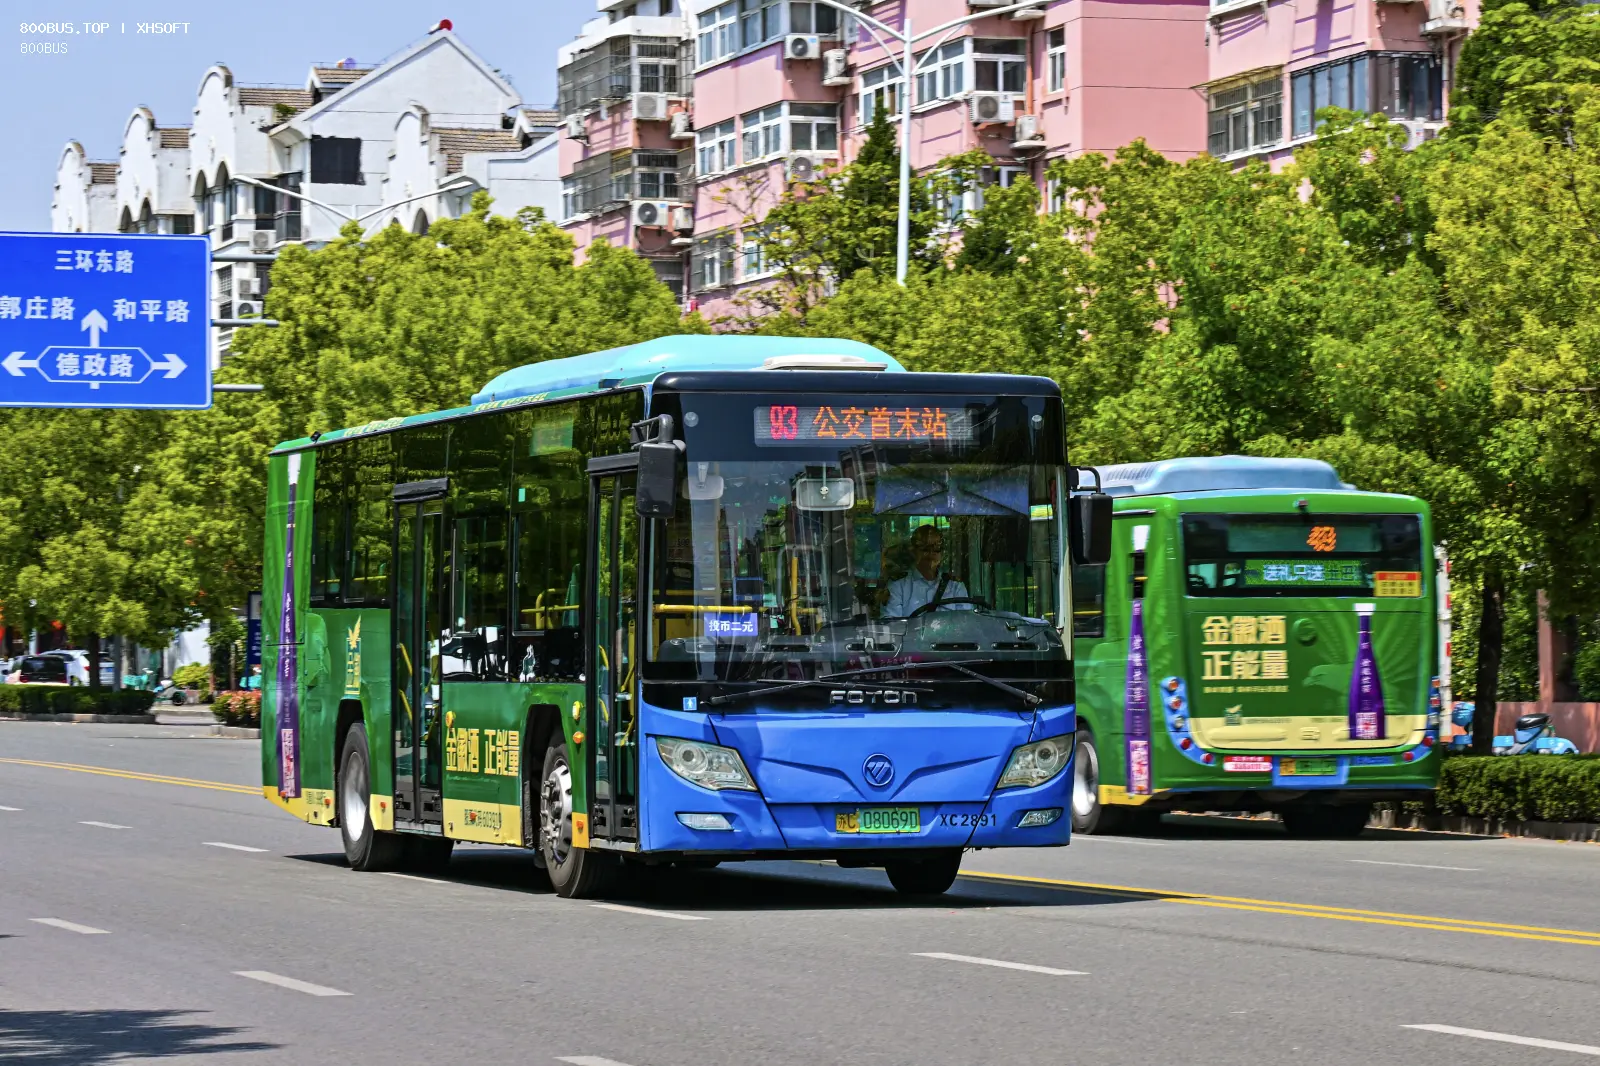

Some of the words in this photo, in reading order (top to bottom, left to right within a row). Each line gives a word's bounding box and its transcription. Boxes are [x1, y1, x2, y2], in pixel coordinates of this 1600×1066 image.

[54, 249, 135, 274] 三环东路
[0, 295, 76, 321] 郭庄路
[112, 298, 190, 323] 和平路
[56, 352, 134, 378] 德政路
[769, 405, 799, 440] 93
[812, 406, 948, 440] 公交首末站
[708, 618, 754, 633] 投币二元
[1201, 615, 1287, 645] 金徽酒
[1201, 650, 1290, 680] 正能量
[829, 690, 918, 704] FOTON
[484, 729, 520, 777] 正能量
[939, 813, 997, 828] XC2891
